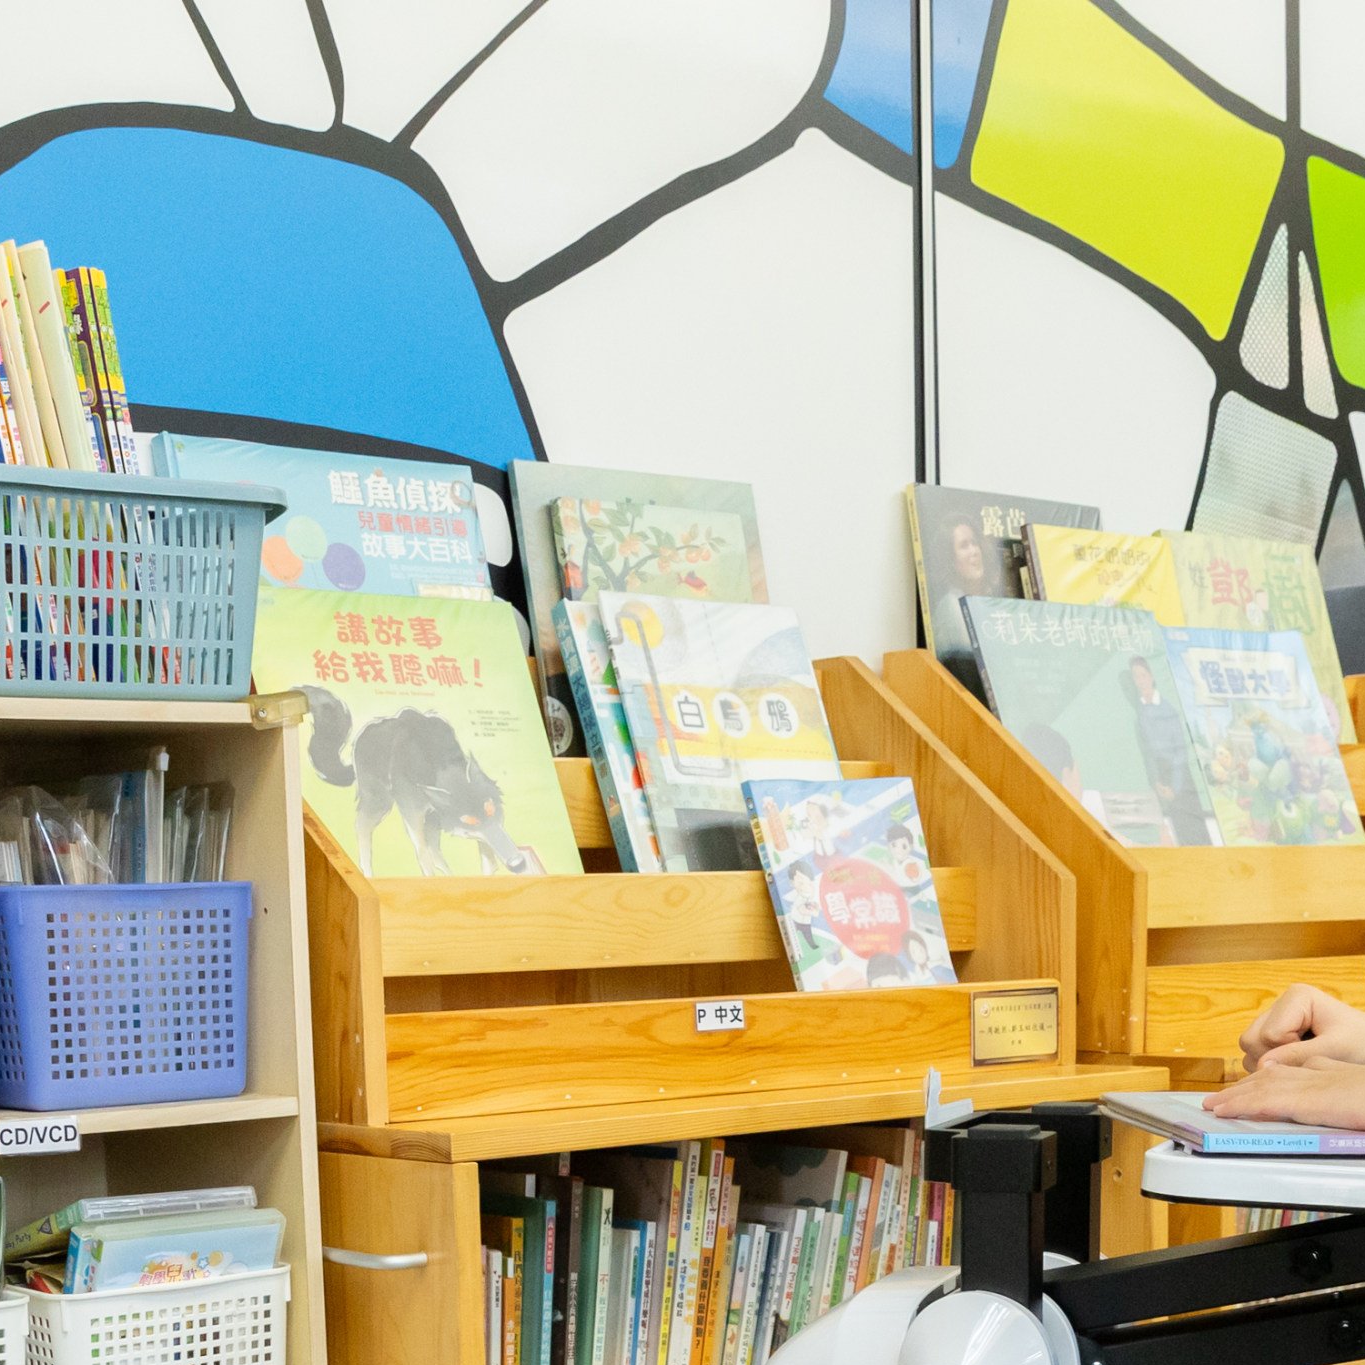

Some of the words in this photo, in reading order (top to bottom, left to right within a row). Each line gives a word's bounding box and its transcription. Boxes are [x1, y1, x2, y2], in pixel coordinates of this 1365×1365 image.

[327, 469, 463, 514] 鱷魚偵探
[359, 510, 469, 538] 兒童情緒引導
[361, 532, 473, 564] 故事大百科
[333, 611, 443, 650] 講故事
[1198, 659, 1292, 697] 怪獸大學
[697, 1008, 707, 1024] P
[715, 1005, 744, 1025] 中文
[1215, 1135, 1275, 1148] EASY-TO-READ
[1282, 1138, 1303, 1147] Level
